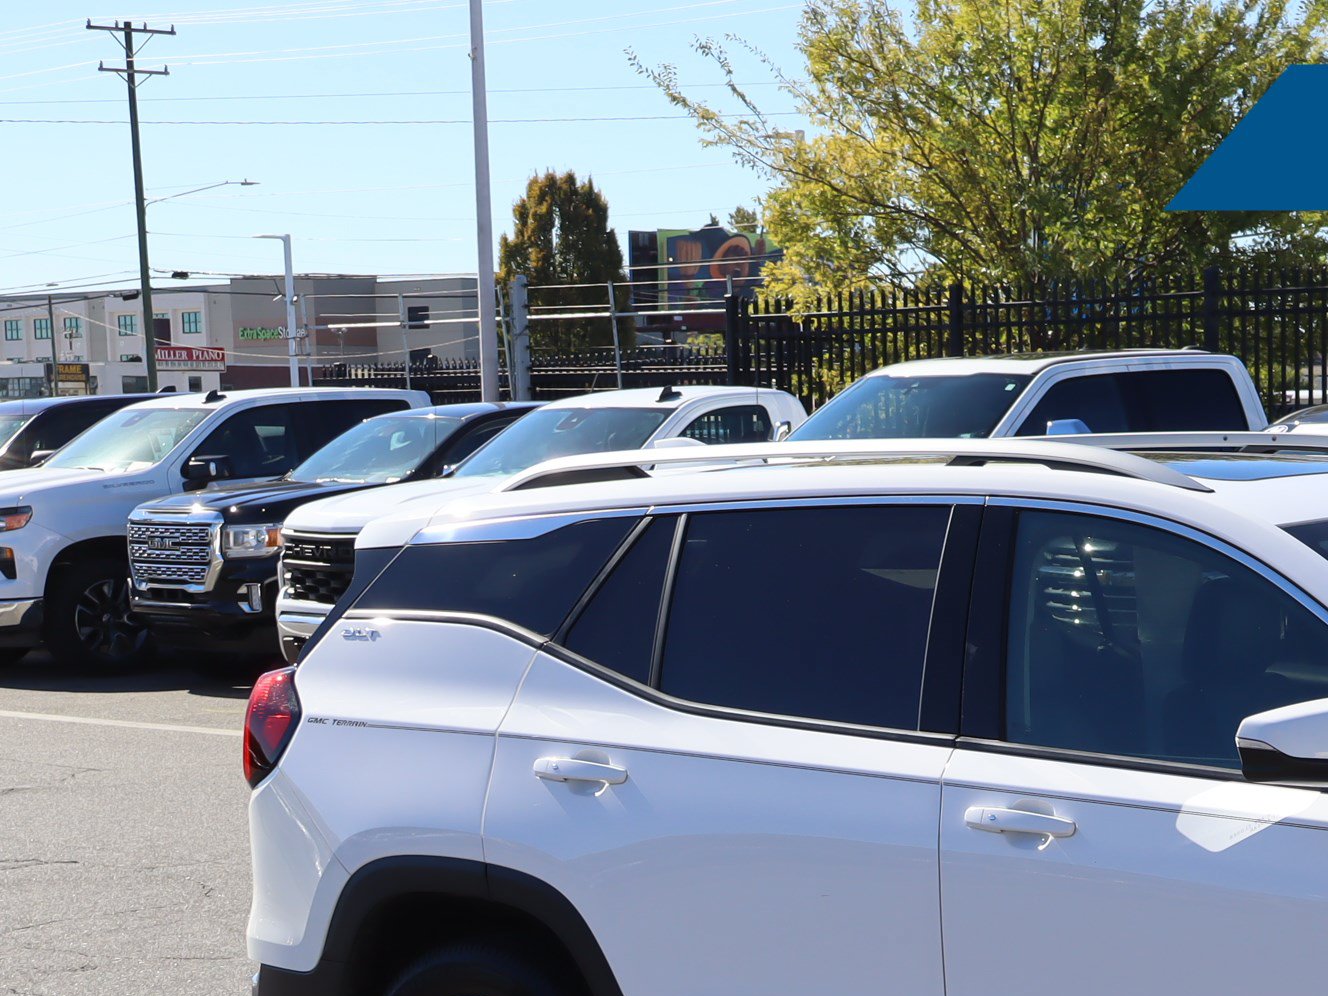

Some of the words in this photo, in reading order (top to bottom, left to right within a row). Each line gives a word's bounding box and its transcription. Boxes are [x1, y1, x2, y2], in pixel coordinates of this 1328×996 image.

[239, 327, 305, 340] ExtraSpaceStoge
[192, 349, 223, 360] PIANO
[147, 537, 181, 550] GMC
[307, 717, 329, 725] GMC
[331, 719, 367, 728] TERRAIN
